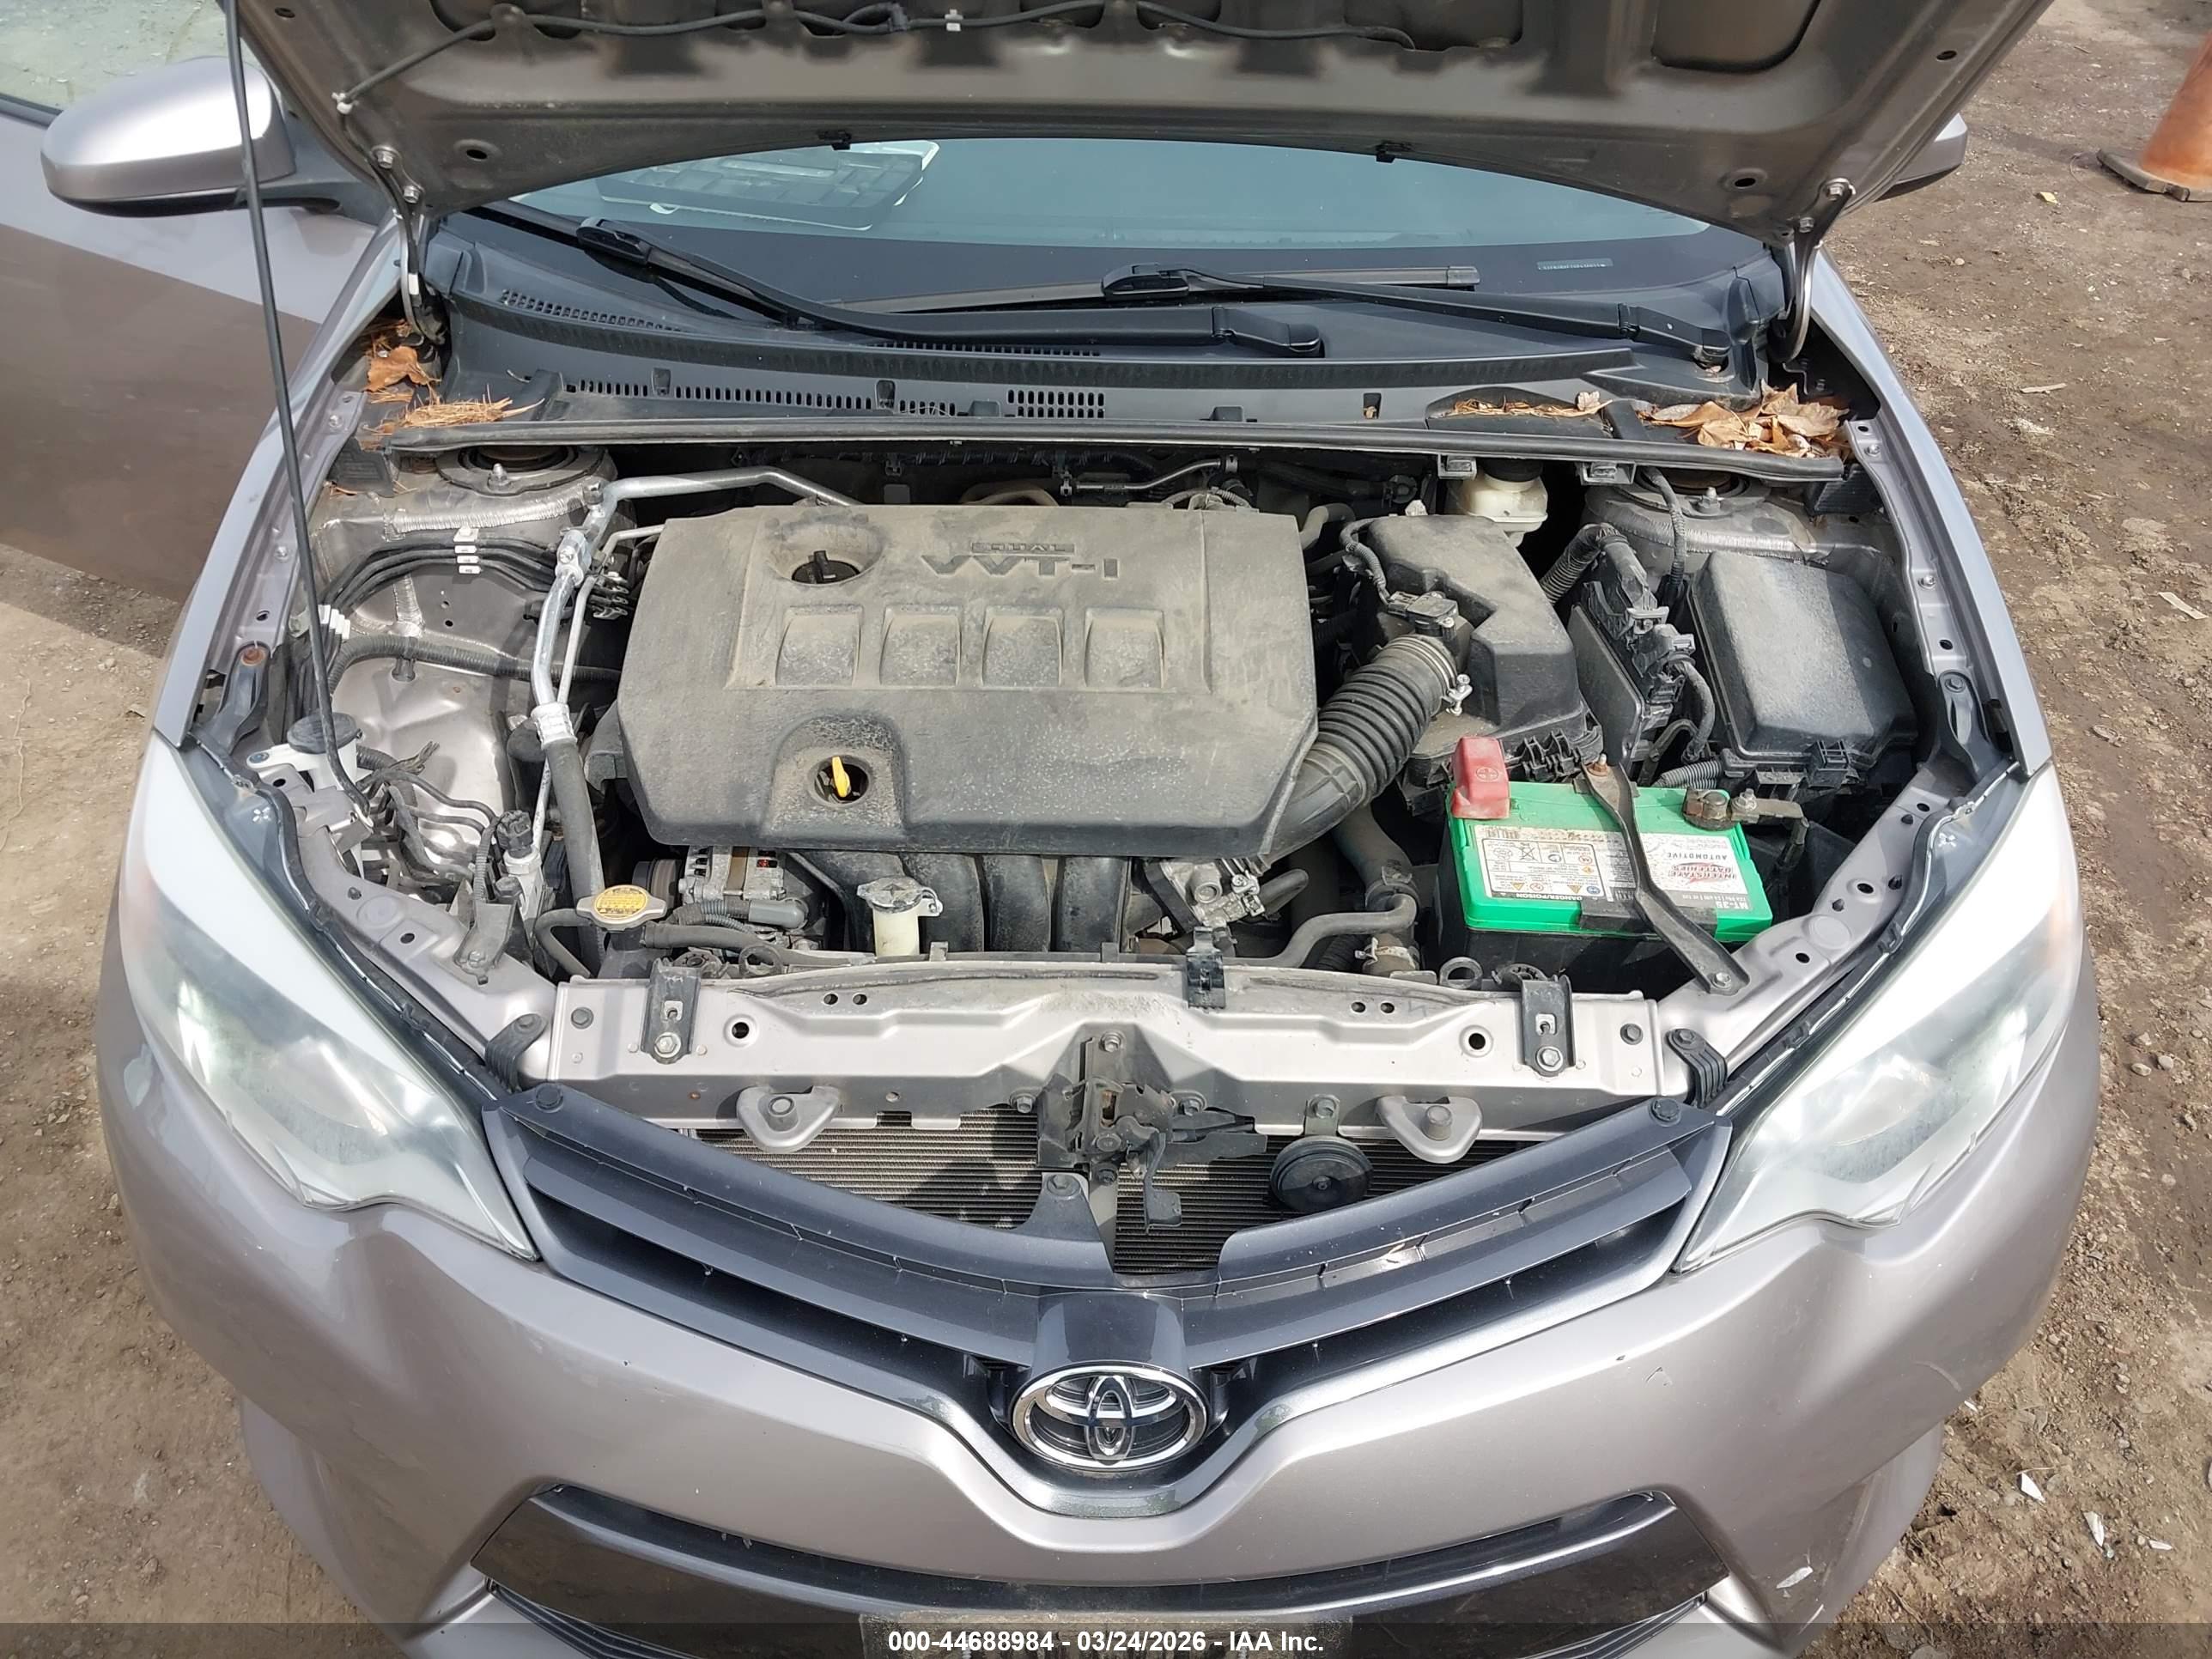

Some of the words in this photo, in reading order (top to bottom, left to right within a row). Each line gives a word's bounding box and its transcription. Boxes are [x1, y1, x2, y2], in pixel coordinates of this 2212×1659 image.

[988, 543, 1066, 551] DUAL
[1667, 853, 1728, 861] AUTOMOTIVE
[1668, 870, 1737, 880] INTERSTATE
